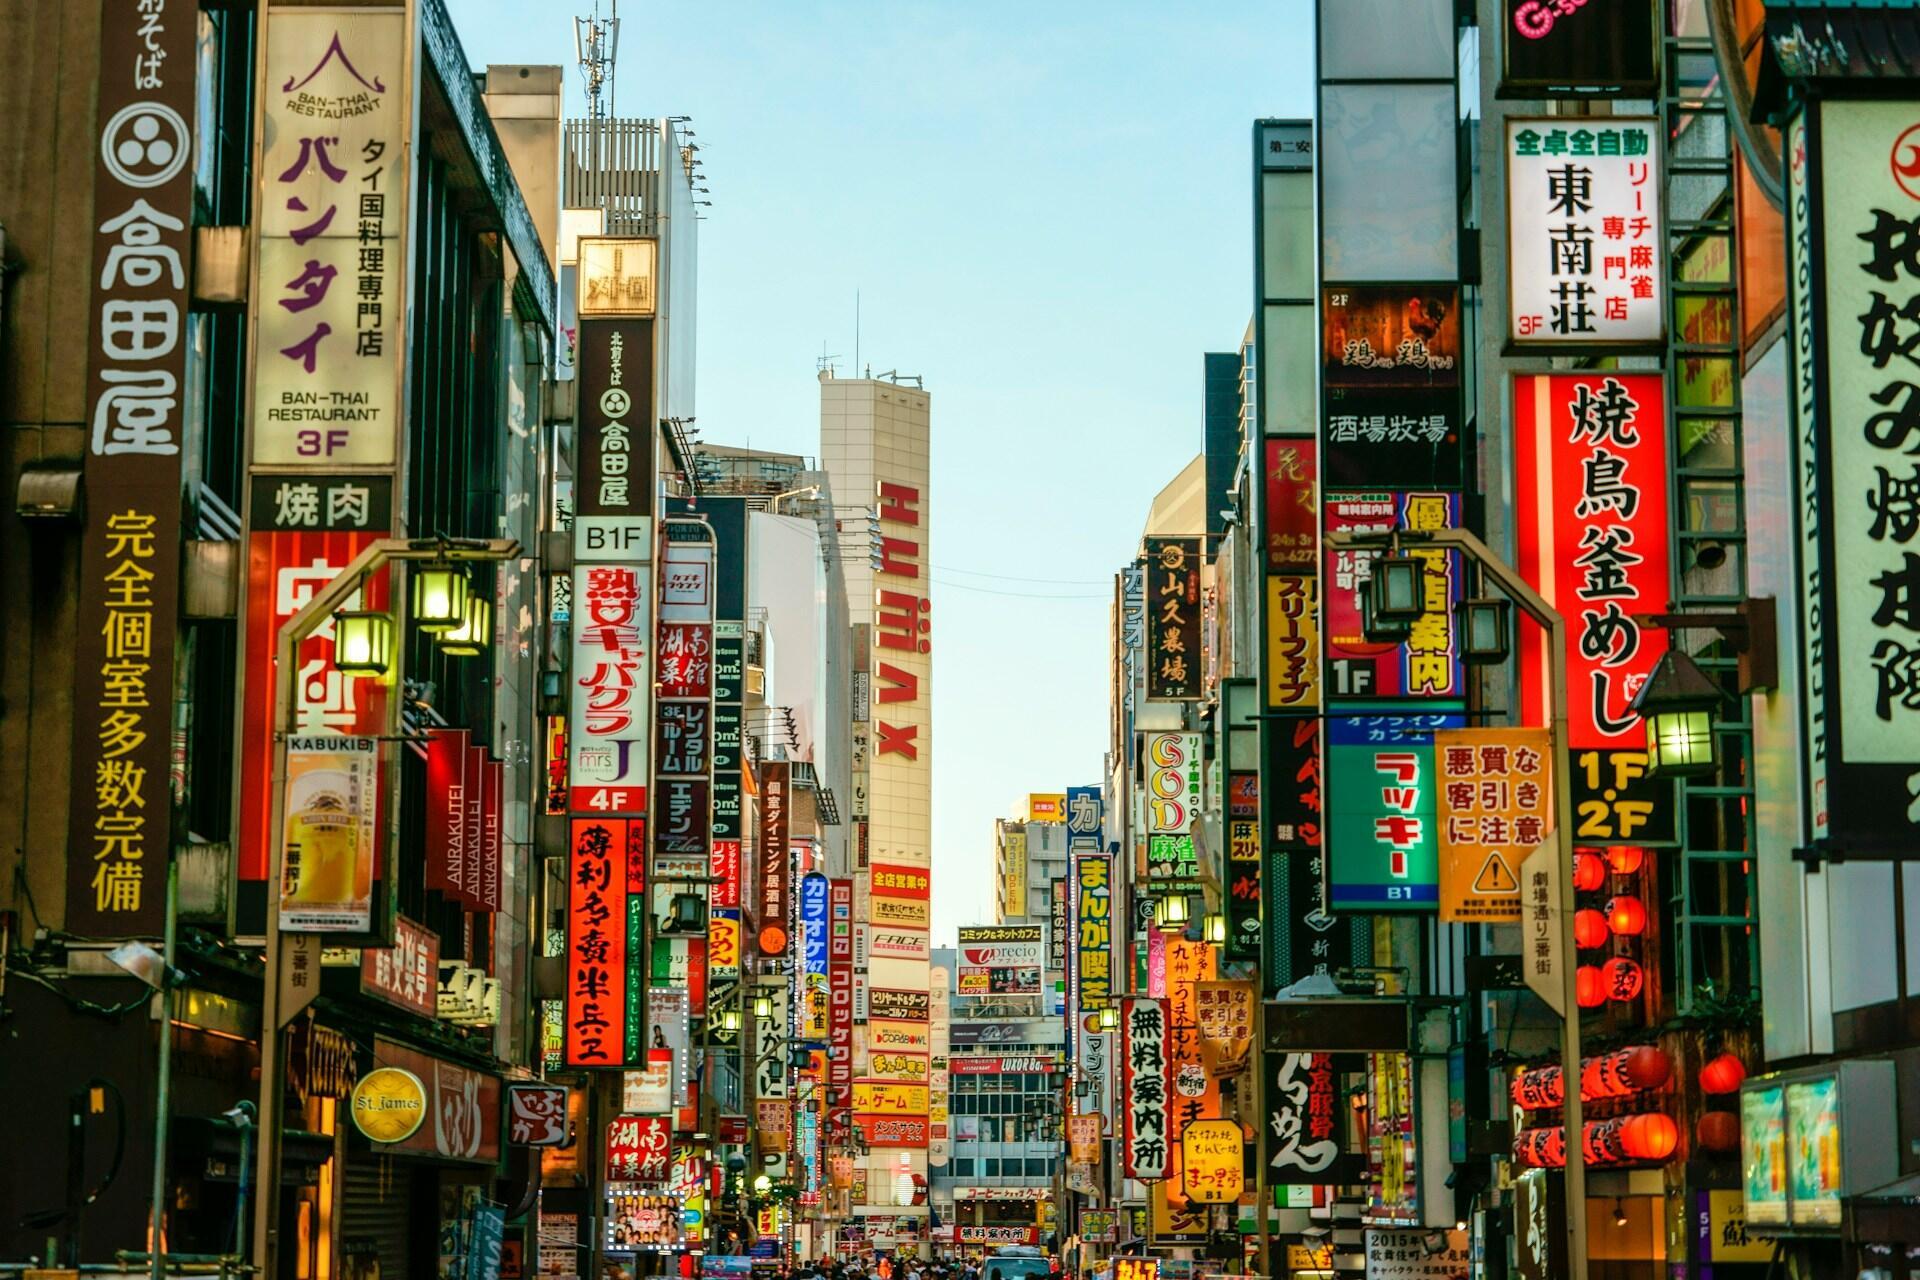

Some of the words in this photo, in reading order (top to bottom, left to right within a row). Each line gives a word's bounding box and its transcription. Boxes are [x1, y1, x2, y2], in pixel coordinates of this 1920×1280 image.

[285, 100, 382, 119] RESTAURANT
[297, 91, 370, 107] BAN-THAI
[1516, 129, 1649, 156] 全卓全自動
[356, 138, 386, 357] タイ国料理専門店
[1547, 163, 1597, 335] 東南荘
[1628, 162, 1653, 299] リーチ麻雀
[277, 136, 348, 373] バンタイ
[1602, 216, 1628, 321] 専門店
[1331, 294, 1349, 306] 2F
[92, 198, 185, 455] 高田屋
[1518, 316, 1543, 335] 3F
[267, 408, 381, 421] RESTAURANT
[281, 392, 369, 405] BAN-THAI
[296, 430, 349, 456] 3F
[1329, 415, 1449, 443] 酒場牧場
[599, 420, 631, 507] 高田屋
[275, 483, 370, 527] 焼肉
[586, 527, 641, 550] B1F
[1569, 378, 1642, 736] 焼鳥釜めし
[578, 567, 646, 737] 熟女キャバクラ
[1332, 659, 1371, 694] 1F
[91, 509, 157, 913] 完全個室多数完備
[662, 723, 682, 772] ルーム
[685, 705, 704, 772] レンタル
[1445, 746, 1541, 776] 悪質な
[1151, 734, 1185, 830] GOD
[1578, 750, 1649, 790] 1F
[588, 788, 628, 811] 4F
[669, 783, 692, 834] エデン
[1374, 753, 1423, 878] ラッキー
[1446, 782, 1542, 811] 客引き
[1577, 801, 1654, 838] 2F
[447, 784, 463, 890] ANRAKUTEI
[466, 800, 481, 902] ANRAKUTEI
[765, 781, 781, 917] 個室ダイニング居酒屋
[1447, 816, 1544, 846] に注意
[286, 843, 302, 896] 一番搾り
[484, 813, 497, 912] ANRAKUTEI
[1387, 887, 1412, 899] B1
[805, 878, 825, 958] カラオケ
[960, 929, 1041, 940] コミック&ネットカフェ
[813, 992, 826, 1029] 麻雀
[873, 1094, 907, 1109] ゲーム
[1131, 1007, 1167, 1169] 無料案内所
